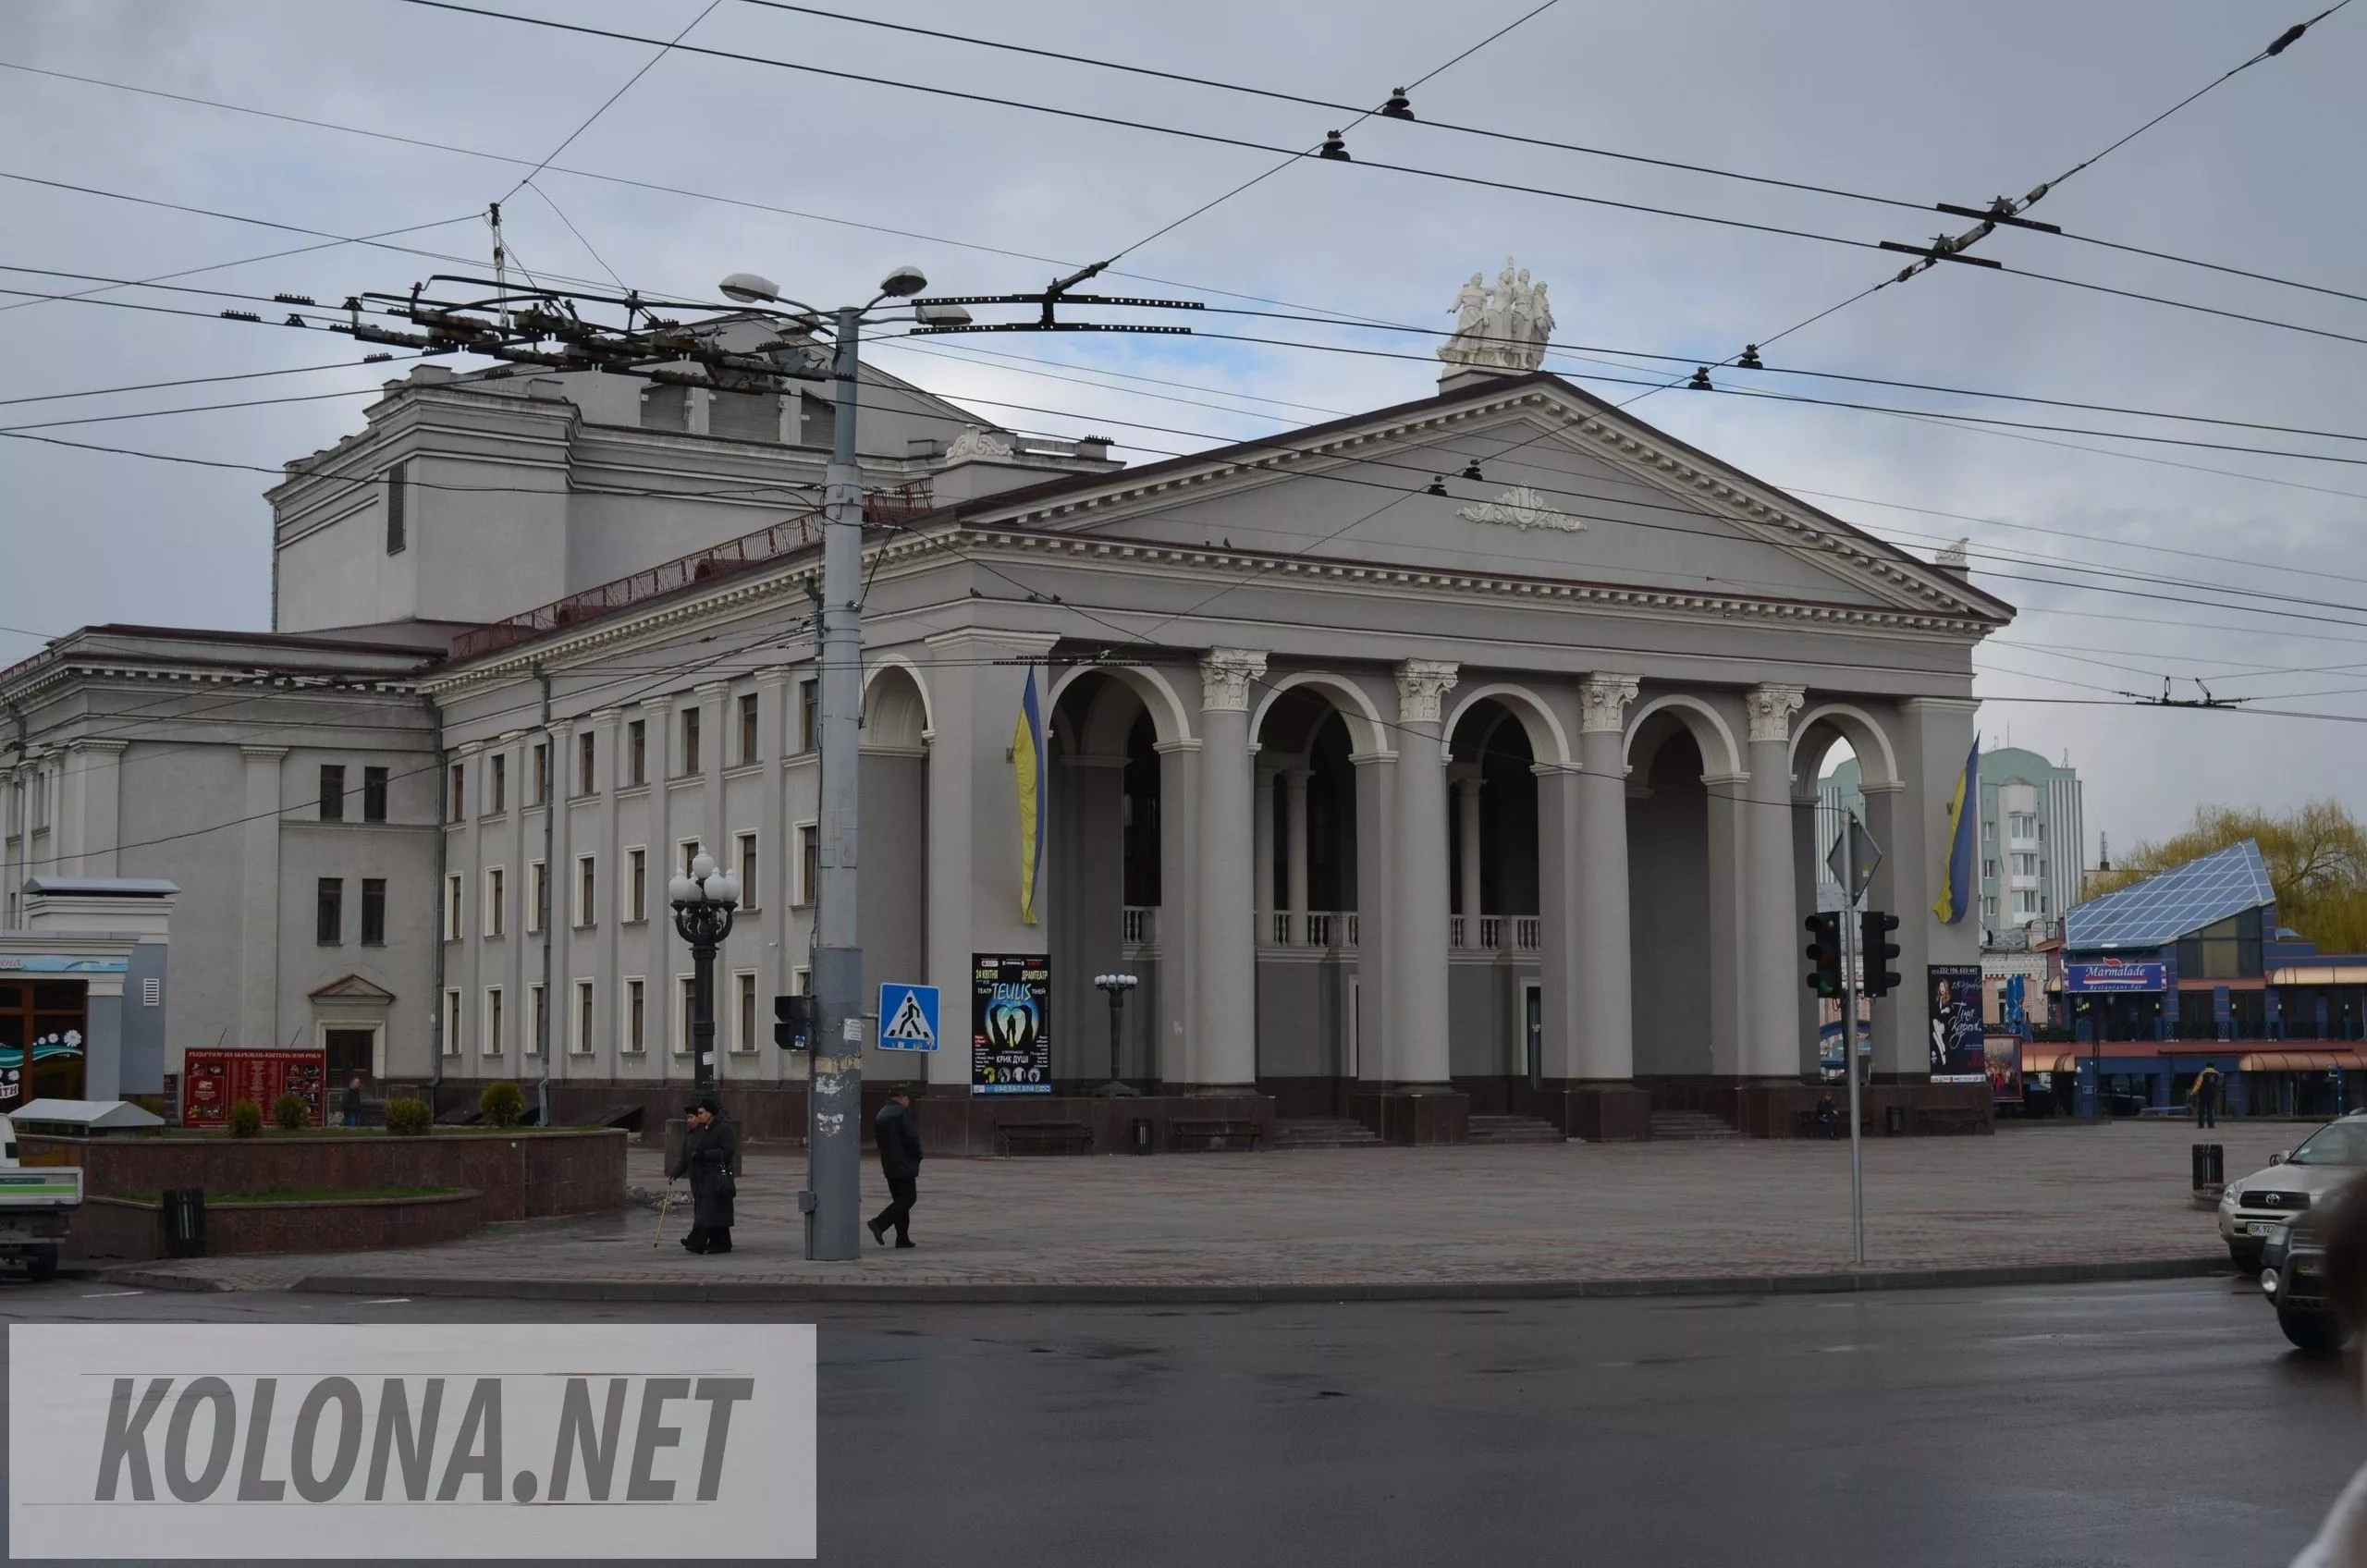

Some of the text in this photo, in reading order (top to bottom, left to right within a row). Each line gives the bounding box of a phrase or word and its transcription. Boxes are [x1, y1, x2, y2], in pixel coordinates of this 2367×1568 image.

[1022, 970, 1048, 982] ДРАМТЕАТР
[2085, 965, 2146, 977] Marmalade
[991, 983, 1032, 1000] TEULIS
[996, 1055, 1029, 1065] КРИК ДУШІ
